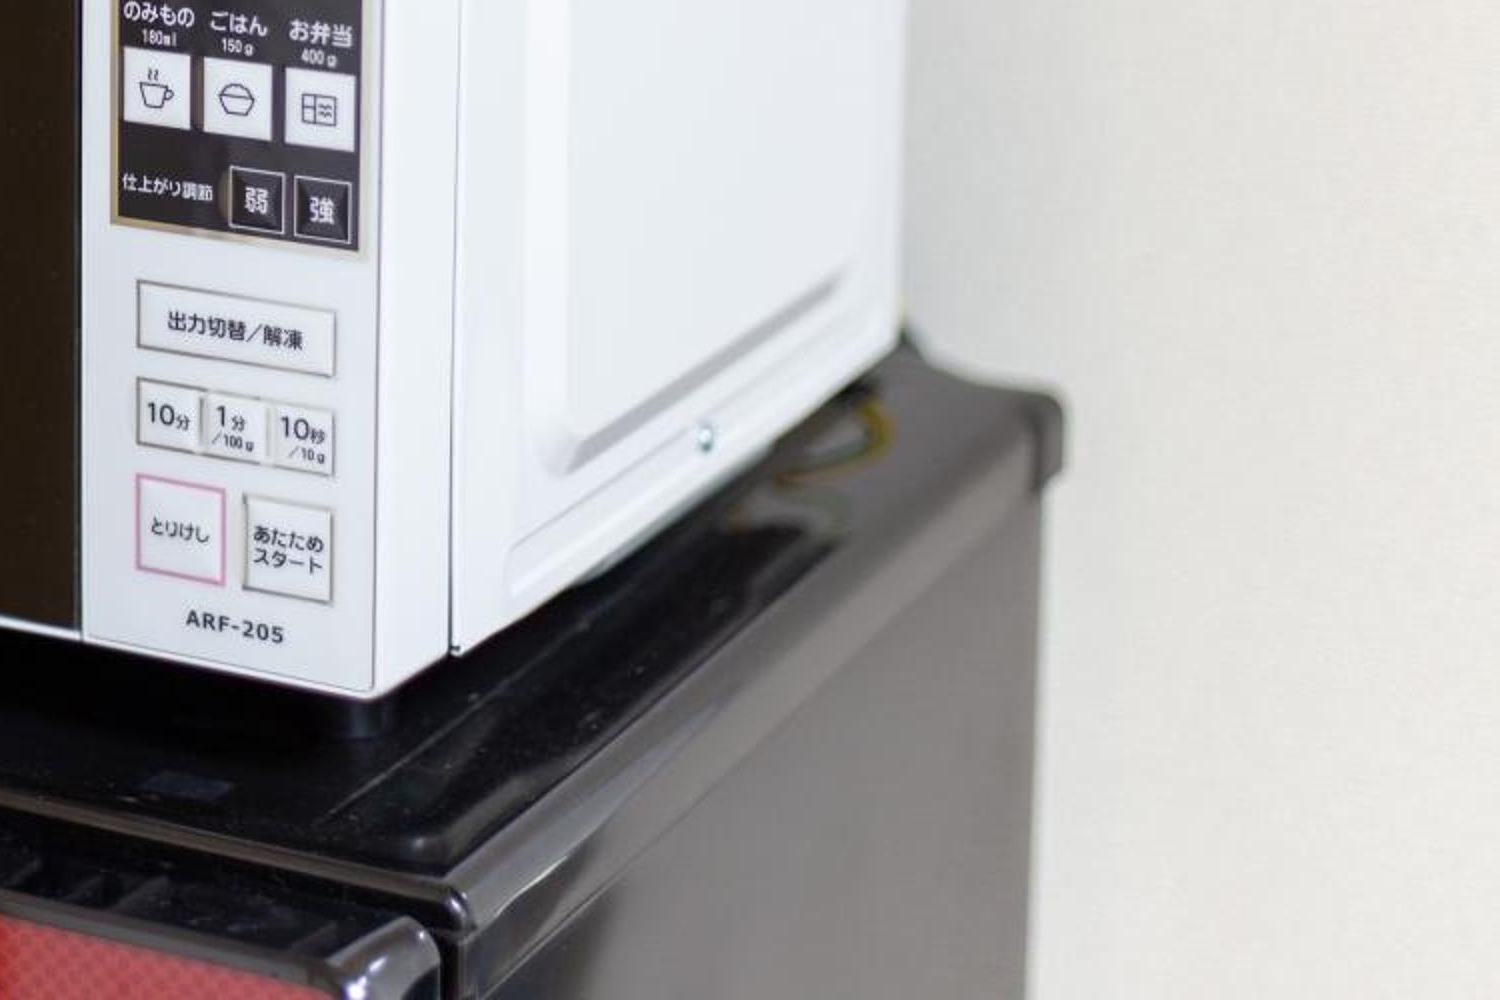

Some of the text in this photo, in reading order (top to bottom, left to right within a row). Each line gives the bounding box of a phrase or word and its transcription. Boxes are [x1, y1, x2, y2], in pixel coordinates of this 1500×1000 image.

[123, 0, 195, 28] のみもの
[209, 10, 268, 37] ごはん
[289, 19, 353, 48] お弁当
[122, 172, 213, 202] 仕上がり調節
[244, 187, 269, 215] 弱
[309, 197, 335, 225] 強
[147, 401, 191, 431] 10分
[280, 415, 326, 444] 10秒
[150, 516, 210, 543] とりけし
[252, 524, 325, 553] あたため
[253, 547, 323, 575] スタート
[185, 609, 285, 644] ARF-205
